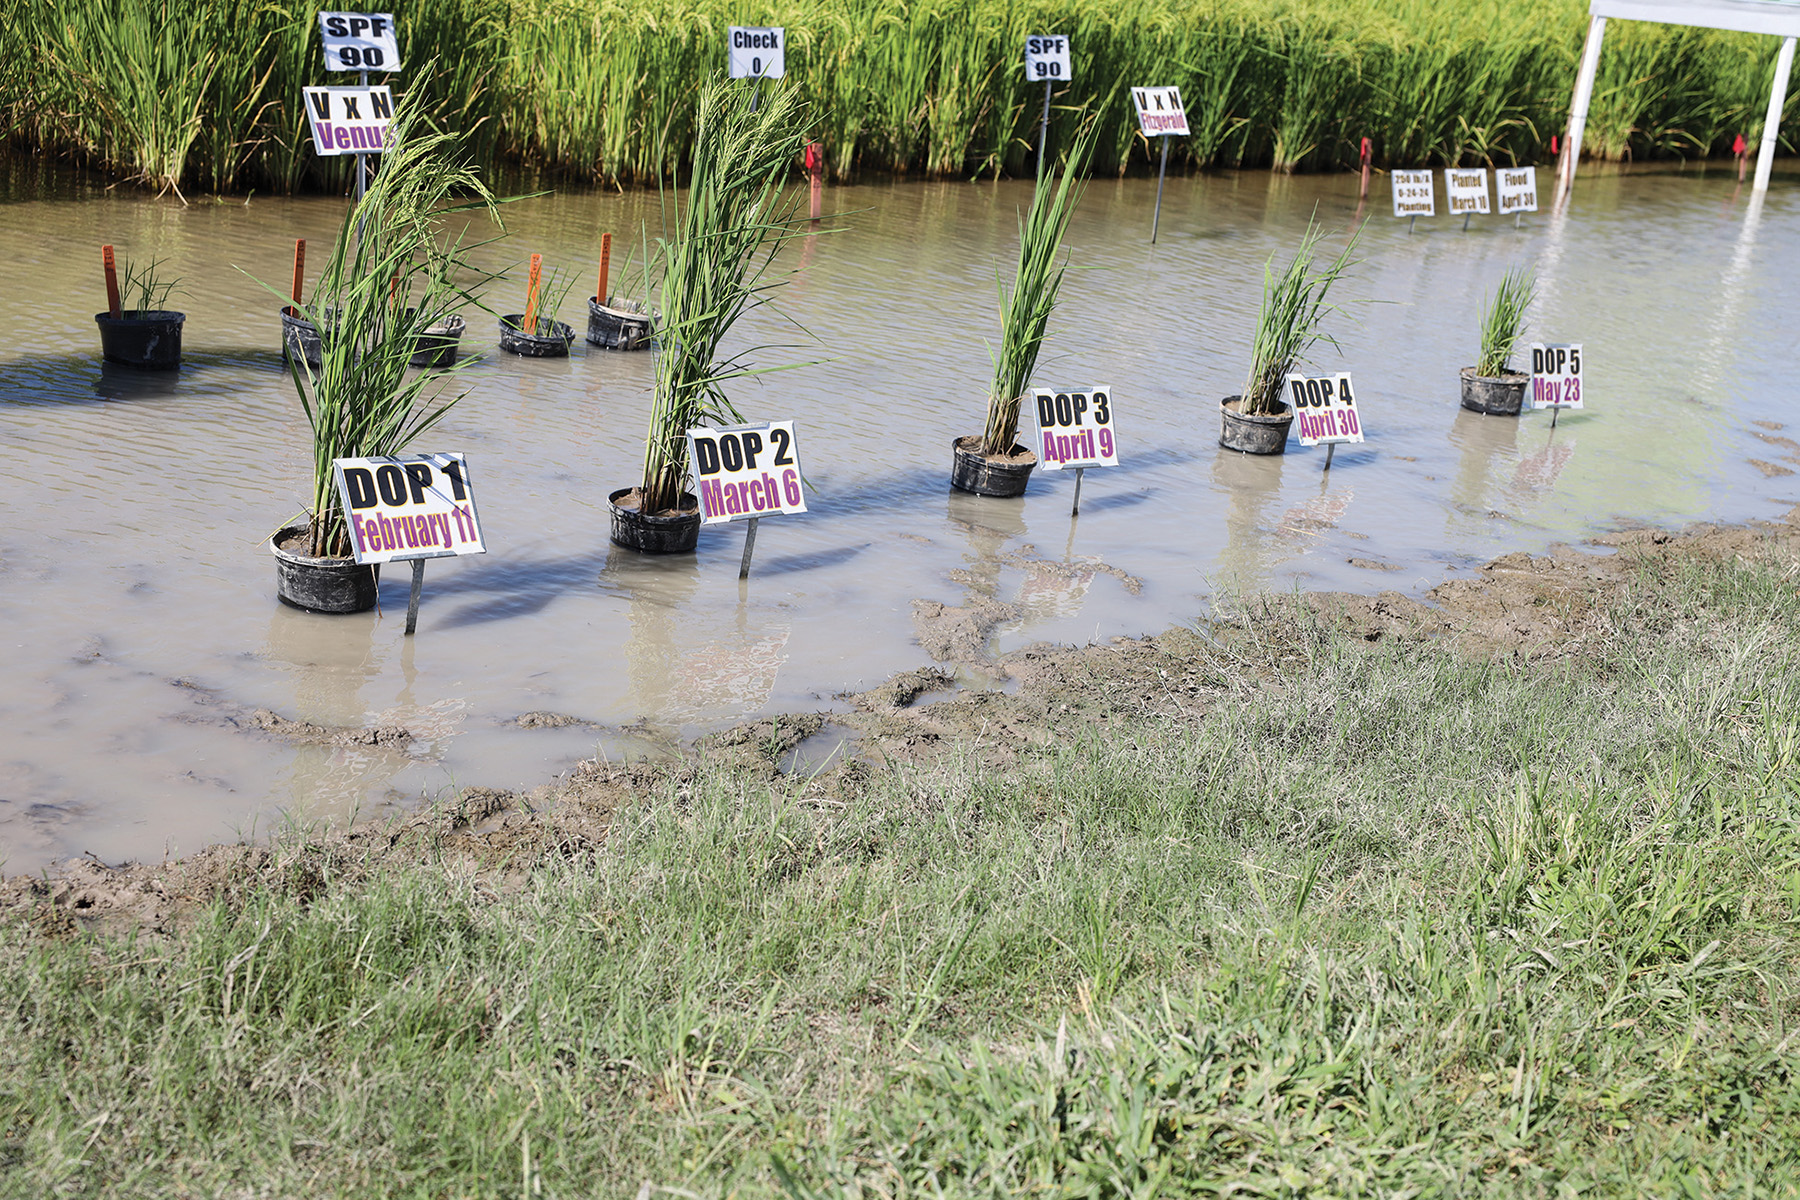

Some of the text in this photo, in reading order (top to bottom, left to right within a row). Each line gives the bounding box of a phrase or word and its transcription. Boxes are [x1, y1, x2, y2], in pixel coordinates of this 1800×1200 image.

[326, 17, 387, 37] SPF
[734, 31, 778, 49] Check
[1029, 39, 1064, 54] SPF
[339, 47, 384, 67] 90
[752, 57, 761, 74] 0
[1035, 61, 1061, 77] 90
[310, 92, 331, 120] V
[370, 92, 392, 119] N
[1136, 91, 1148, 110] V
[1168, 91, 1181, 110] N
[1141, 112, 1186, 131] Fitzgerald
[1451, 173, 1482, 187] Planted
[1504, 173, 1527, 186] Flood
[1397, 203, 1431, 212] Planting
[1451, 195, 1476, 210] March
[1502, 193, 1521, 209] April
[1533, 348, 1580, 375] DOP 5
[1291, 378, 1353, 408] DOP 4
[1533, 377, 1580, 404] May 23
[1037, 392, 1110, 427] DOP 3
[1299, 409, 1359, 440] April 30
[694, 428, 794, 476] DOP 2
[1043, 427, 1114, 464] April 9
[343, 460, 467, 509] DOP 1
[700, 468, 801, 518] March 6
[352, 504, 477, 553] February 11
